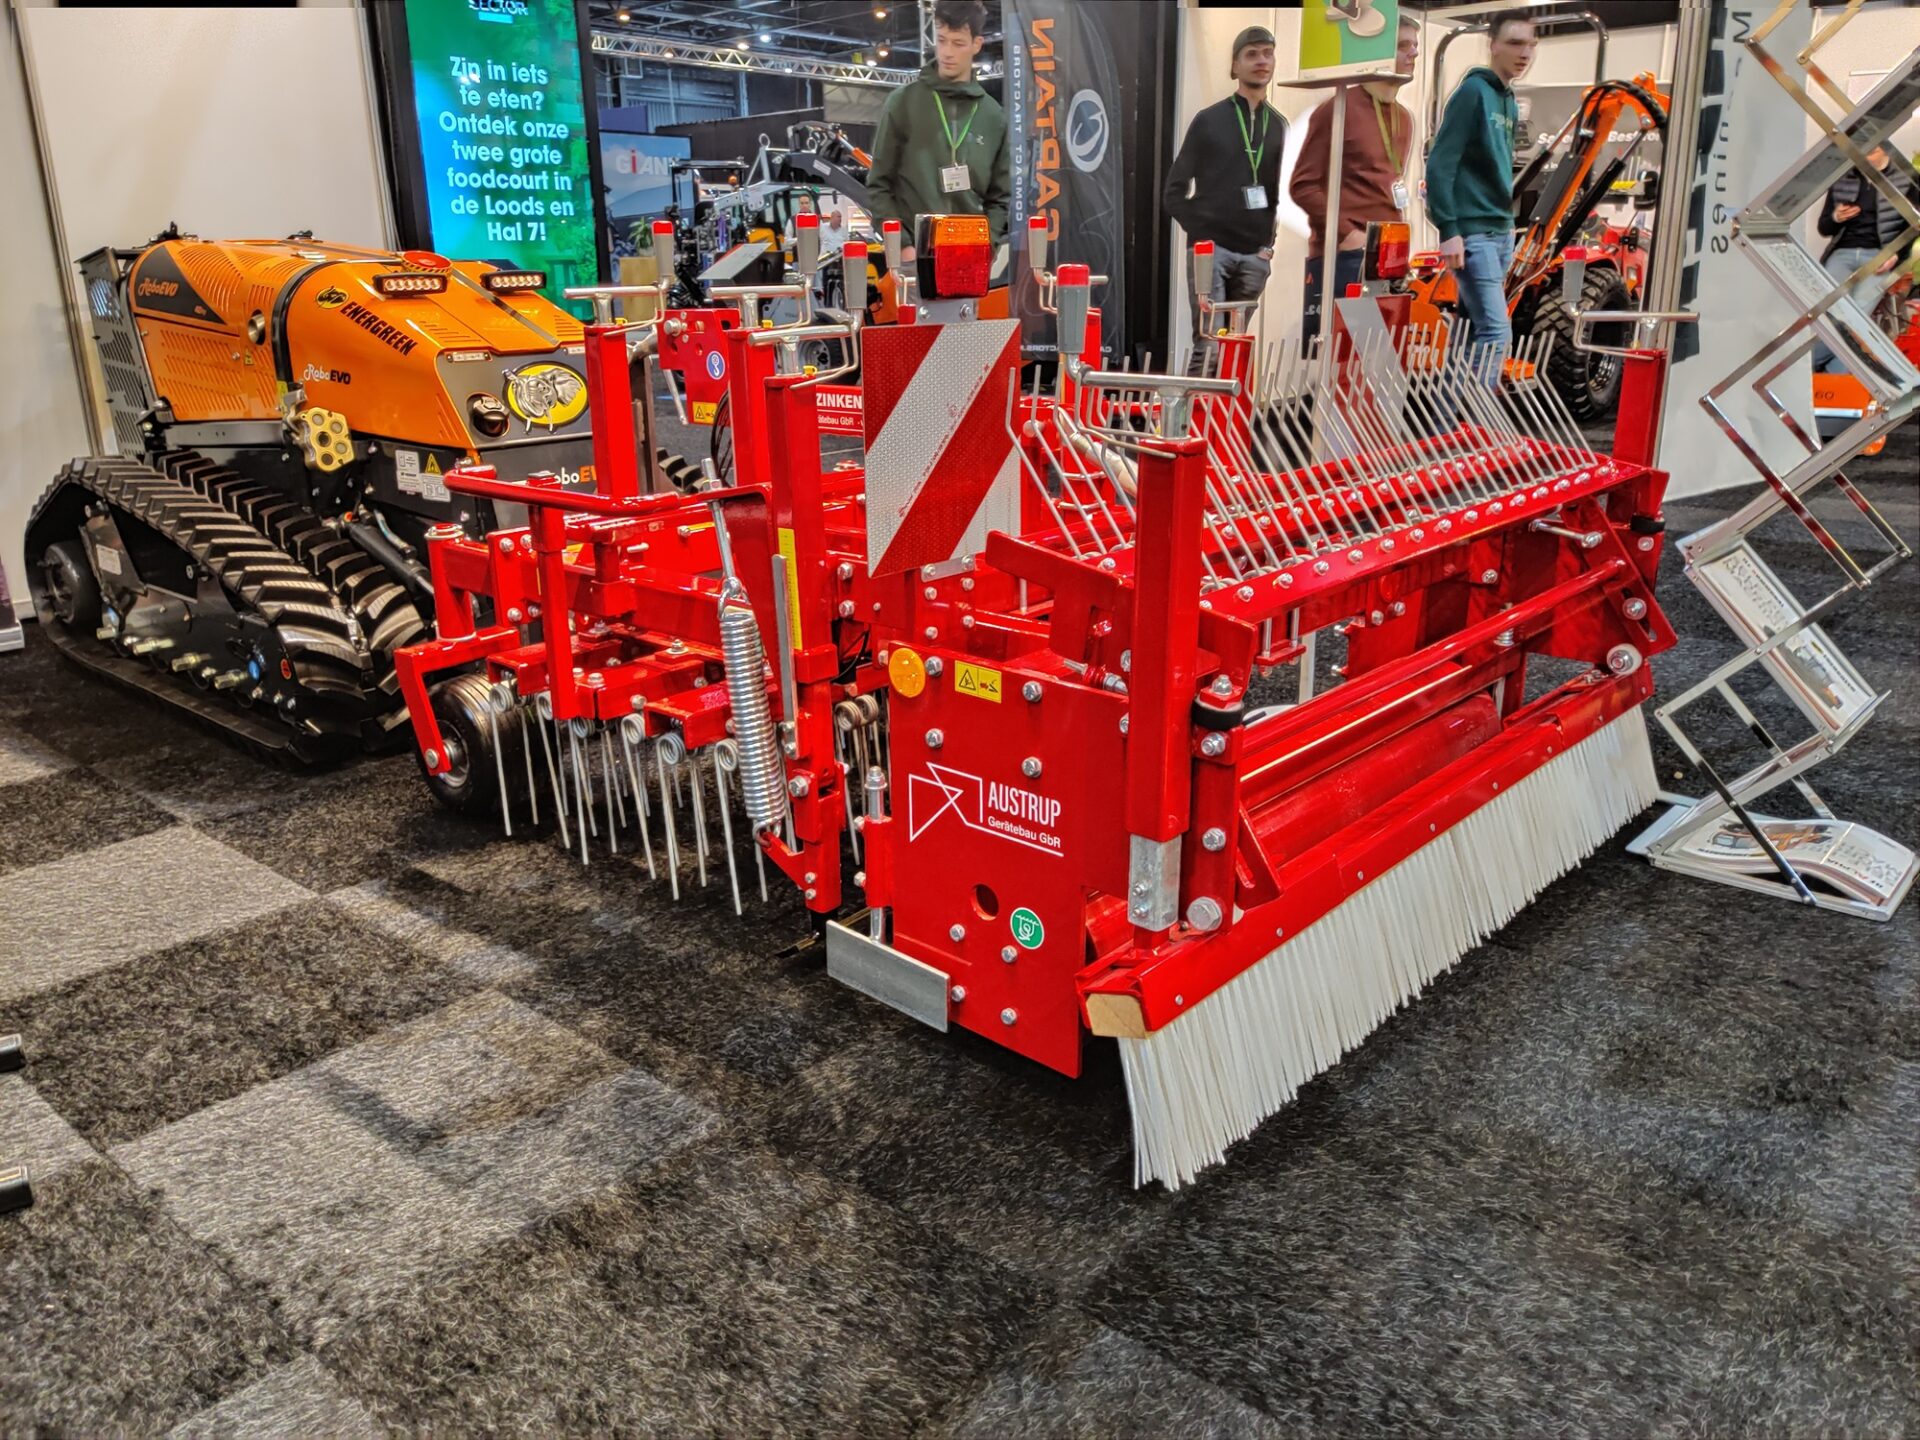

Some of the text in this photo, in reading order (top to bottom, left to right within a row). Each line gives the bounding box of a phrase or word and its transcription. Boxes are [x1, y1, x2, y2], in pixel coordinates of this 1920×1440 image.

[449, 56, 548, 85] Zip in iets
[459, 86, 544, 110] te eten?
[439, 111, 569, 139] Ontdek onze
[452, 140, 562, 167] twee grote
[447, 167, 572, 190] foodcourt in
[451, 195, 575, 216] de Loods en
[487, 222, 547, 241] Hal 7!
[340, 301, 418, 357] ENERGREEN
[303, 363, 352, 385] RoboEVO
[816, 393, 863, 409] ZINKEN
[987, 781, 1061, 828] AUSTRUP
[987, 815, 1061, 848] Gerätebau GbR
